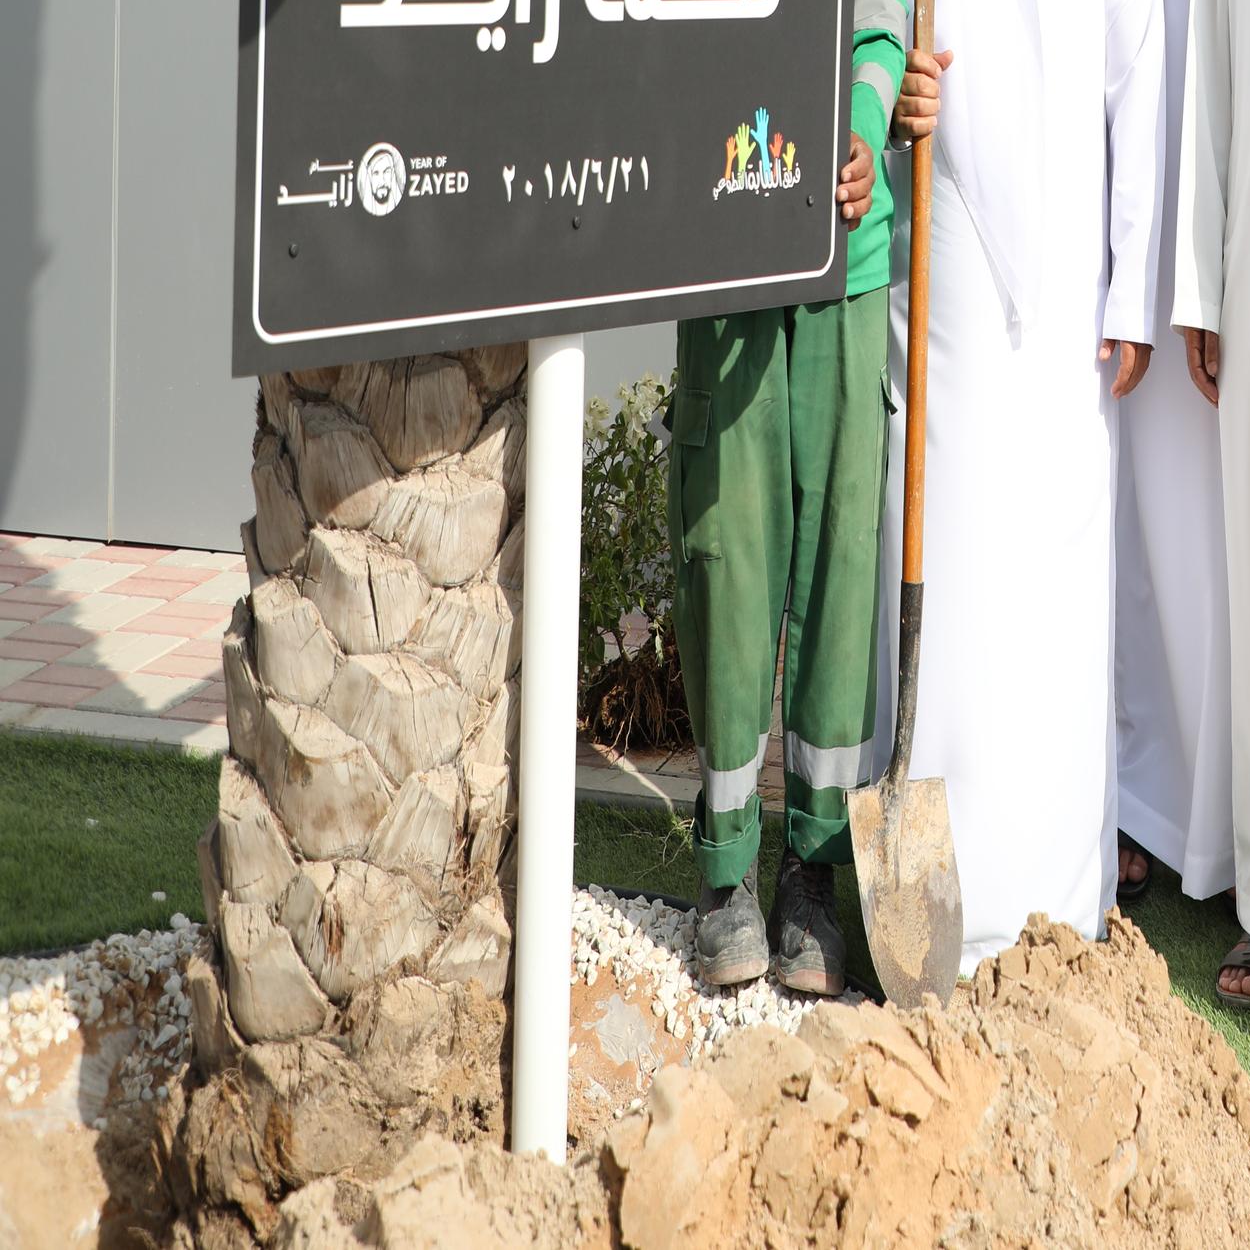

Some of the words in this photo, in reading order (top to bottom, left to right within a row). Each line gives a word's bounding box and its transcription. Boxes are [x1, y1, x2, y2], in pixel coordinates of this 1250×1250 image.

[309, 158, 354, 175] عام
[410, 157, 433, 169] YEAR
[435, 156, 447, 168] OF
[782, 162, 801, 189] فريق
[277, 173, 353, 207] زايد
[409, 171, 468, 197] ZAYED
[713, 171, 748, 200] التطوعي
[747, 157, 782, 197] النيابة
